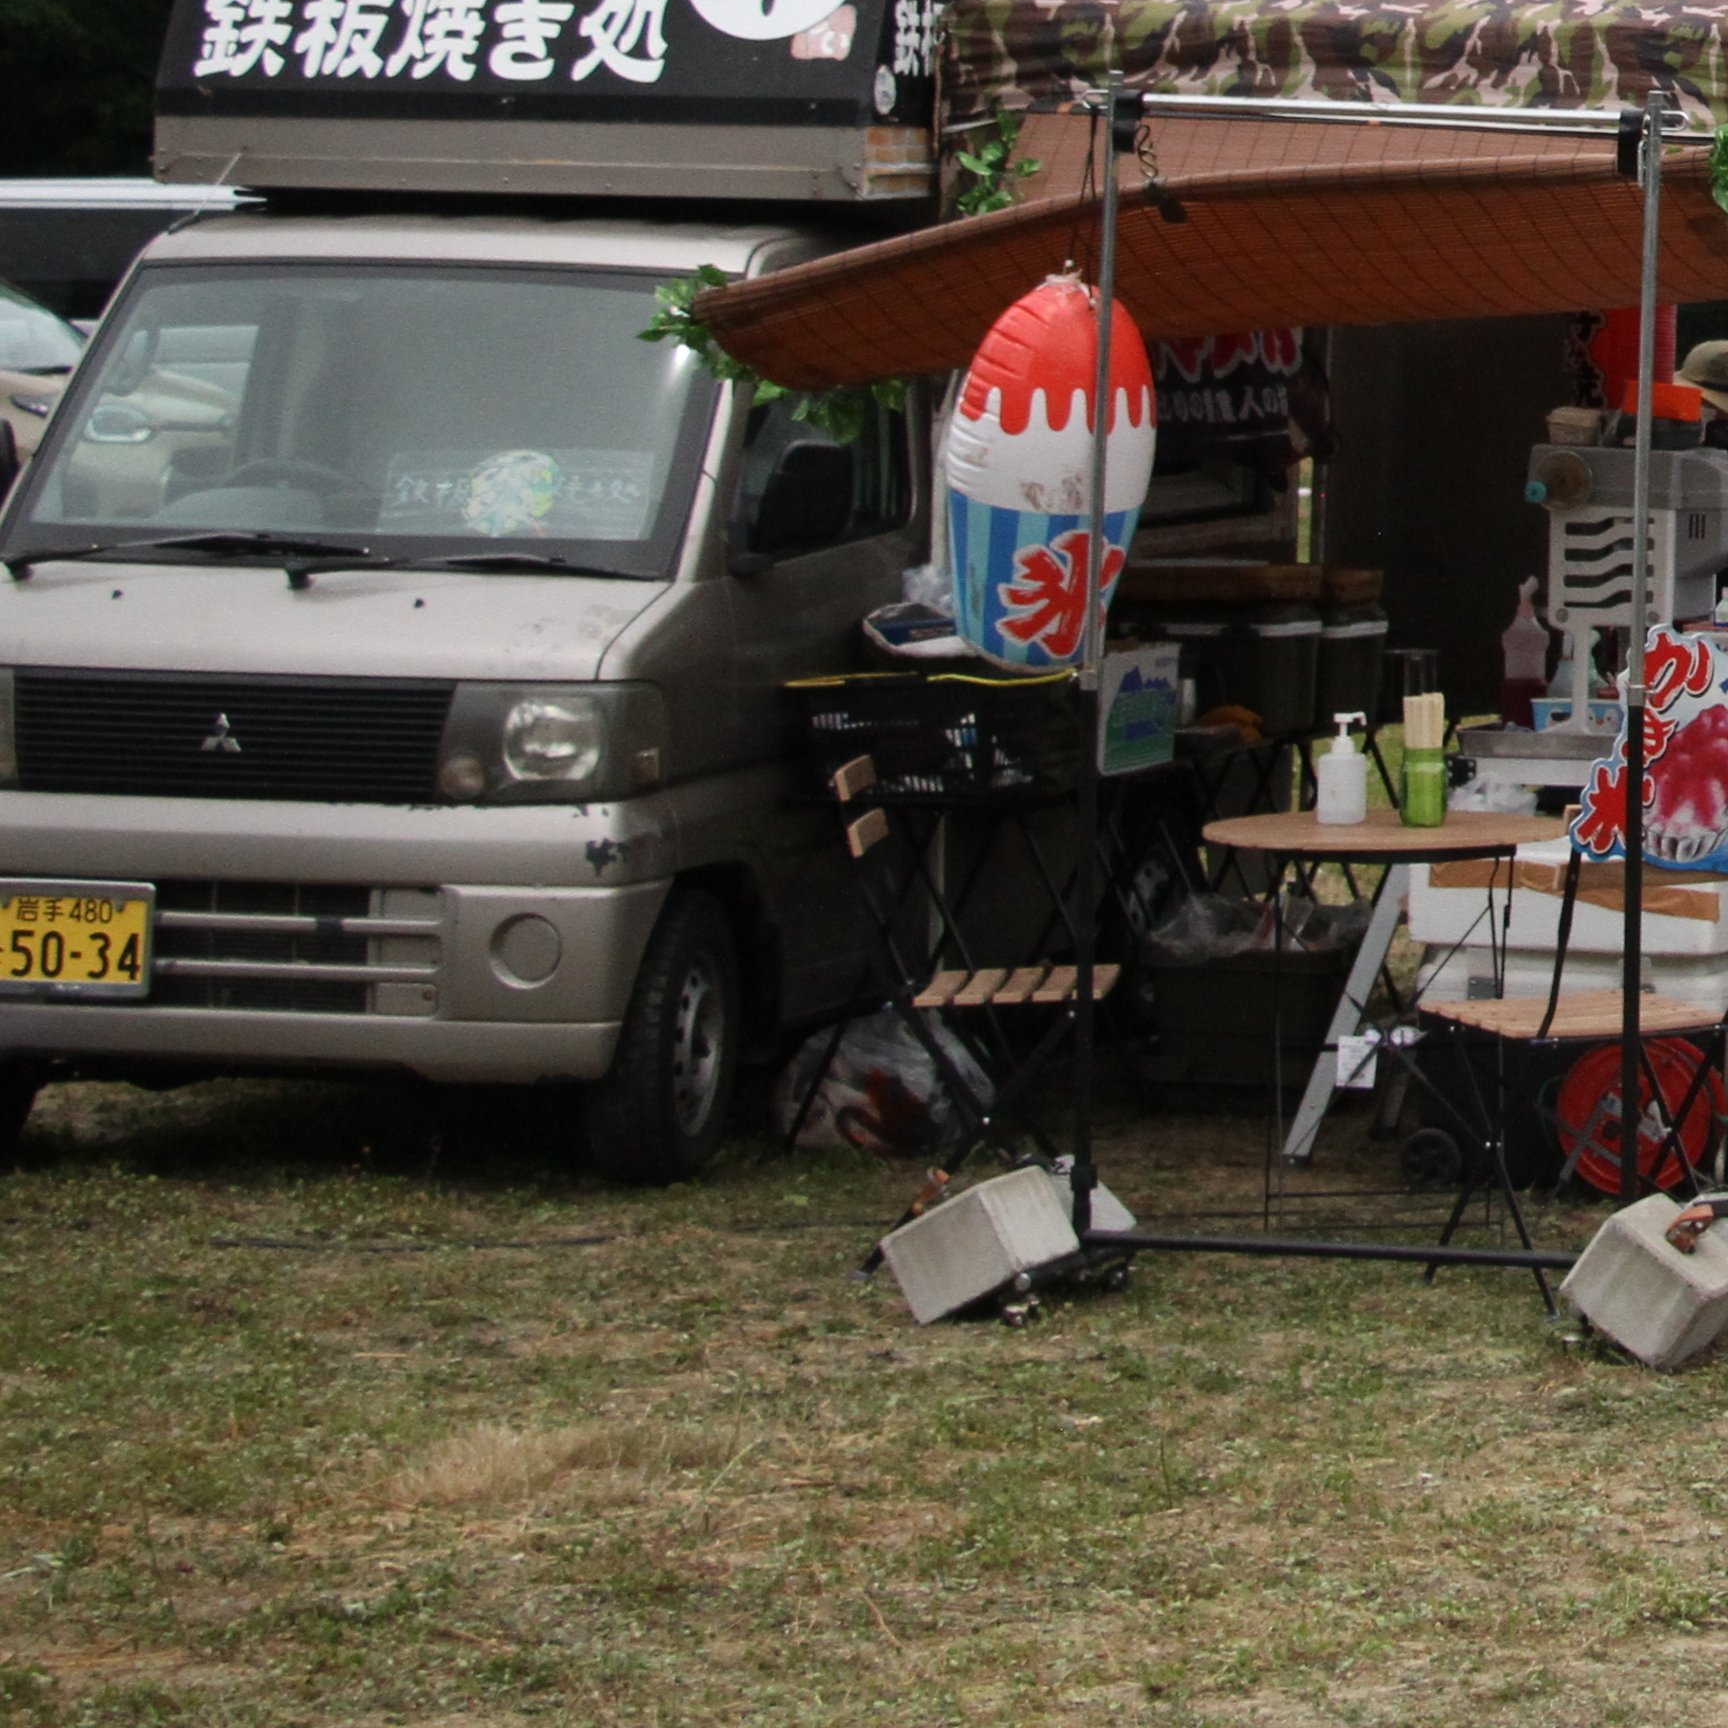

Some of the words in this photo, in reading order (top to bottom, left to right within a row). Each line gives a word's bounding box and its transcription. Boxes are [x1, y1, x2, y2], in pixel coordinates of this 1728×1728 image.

[16, 897, 64, 922] 岩手
[69, 899, 113, 923] 480
[10, 929, 141, 981] 50-34
